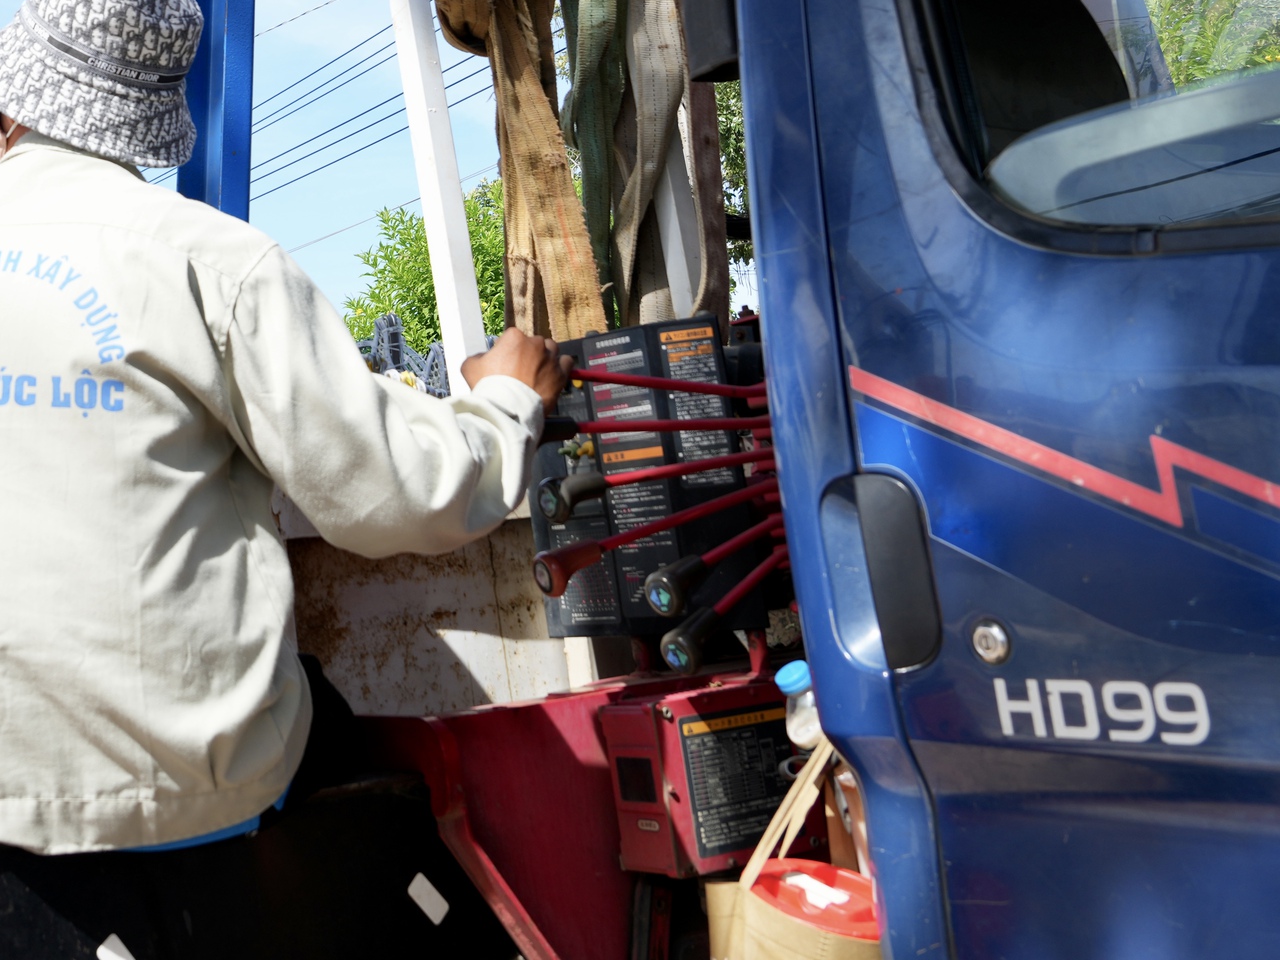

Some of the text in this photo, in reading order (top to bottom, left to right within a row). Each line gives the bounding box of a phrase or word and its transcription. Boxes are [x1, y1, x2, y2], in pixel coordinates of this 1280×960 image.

[87, 57, 160, 82] CHRISTIAN DIOR
[26, 253, 82, 291] XÂY
[73, 286, 126, 365] DỰNG
[51, 369, 125, 418] LỘC
[993, 678, 1211, 746] HD99
